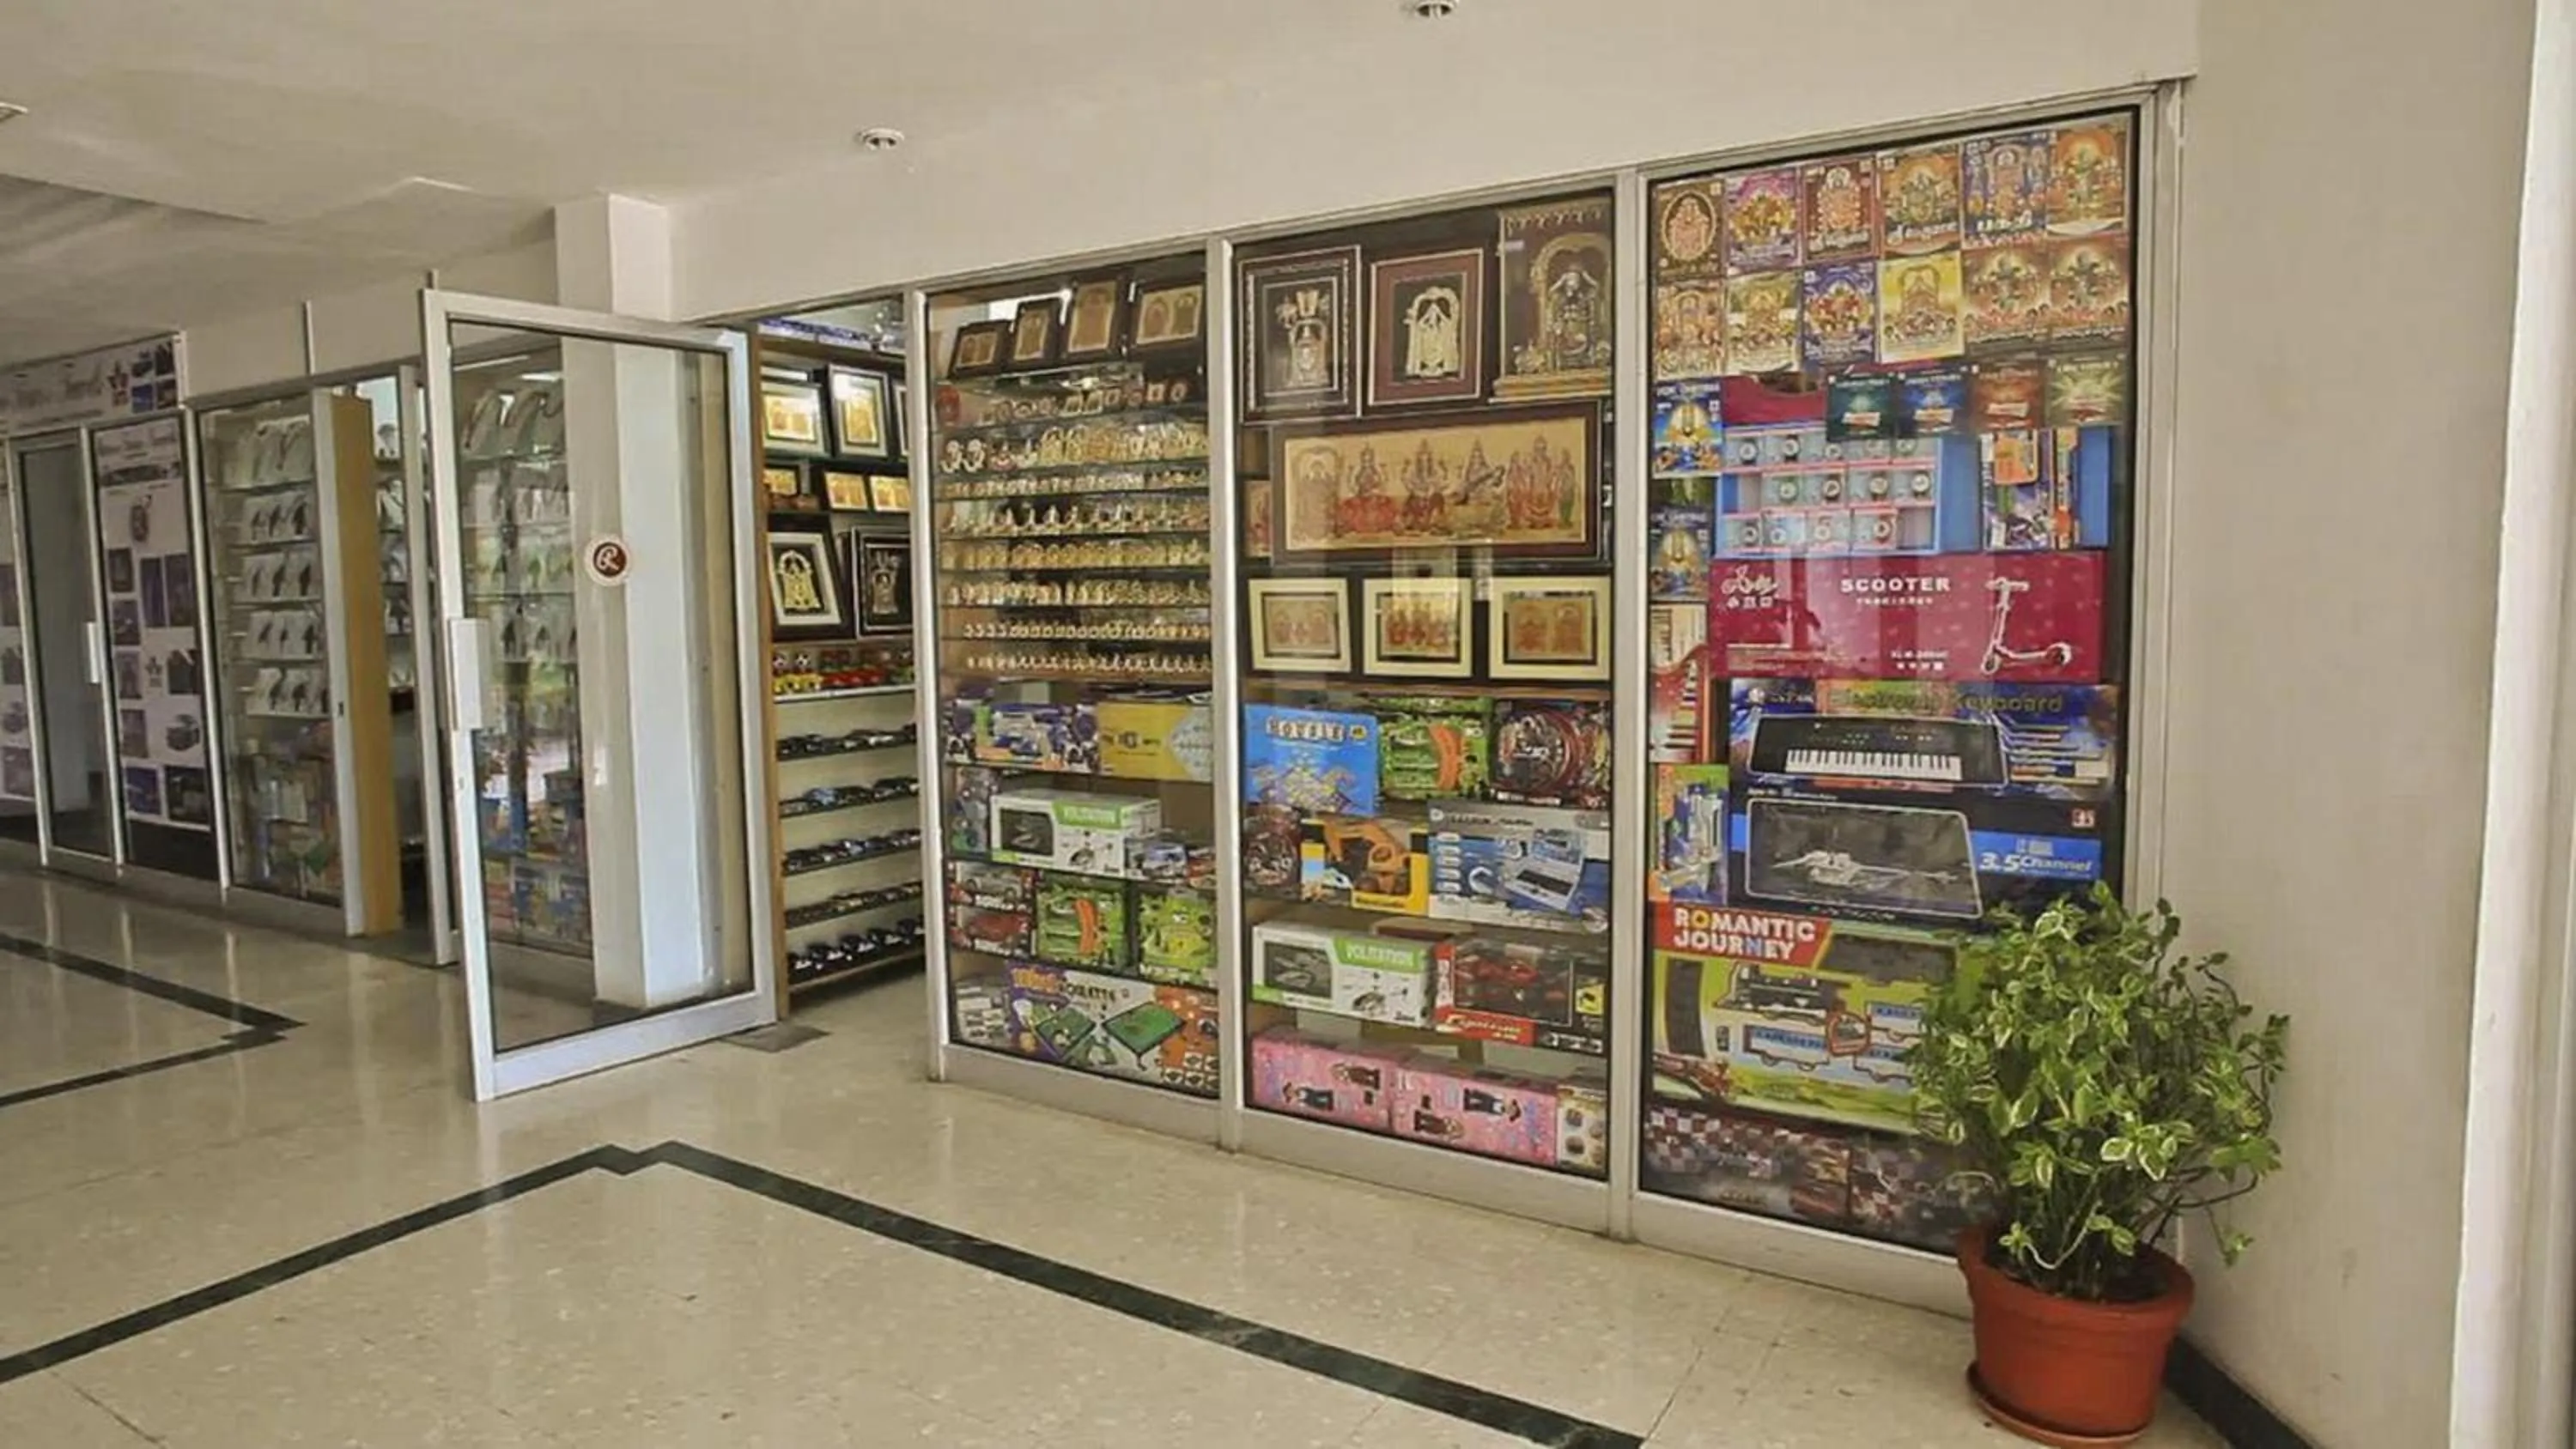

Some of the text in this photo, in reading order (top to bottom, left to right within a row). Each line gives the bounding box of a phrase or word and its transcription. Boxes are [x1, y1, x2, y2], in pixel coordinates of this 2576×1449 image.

[1840, 577, 1951, 593] SCOOTER
[1674, 906, 1816, 943] ROMANTIC
[1674, 930, 1796, 961] JOURNEY
